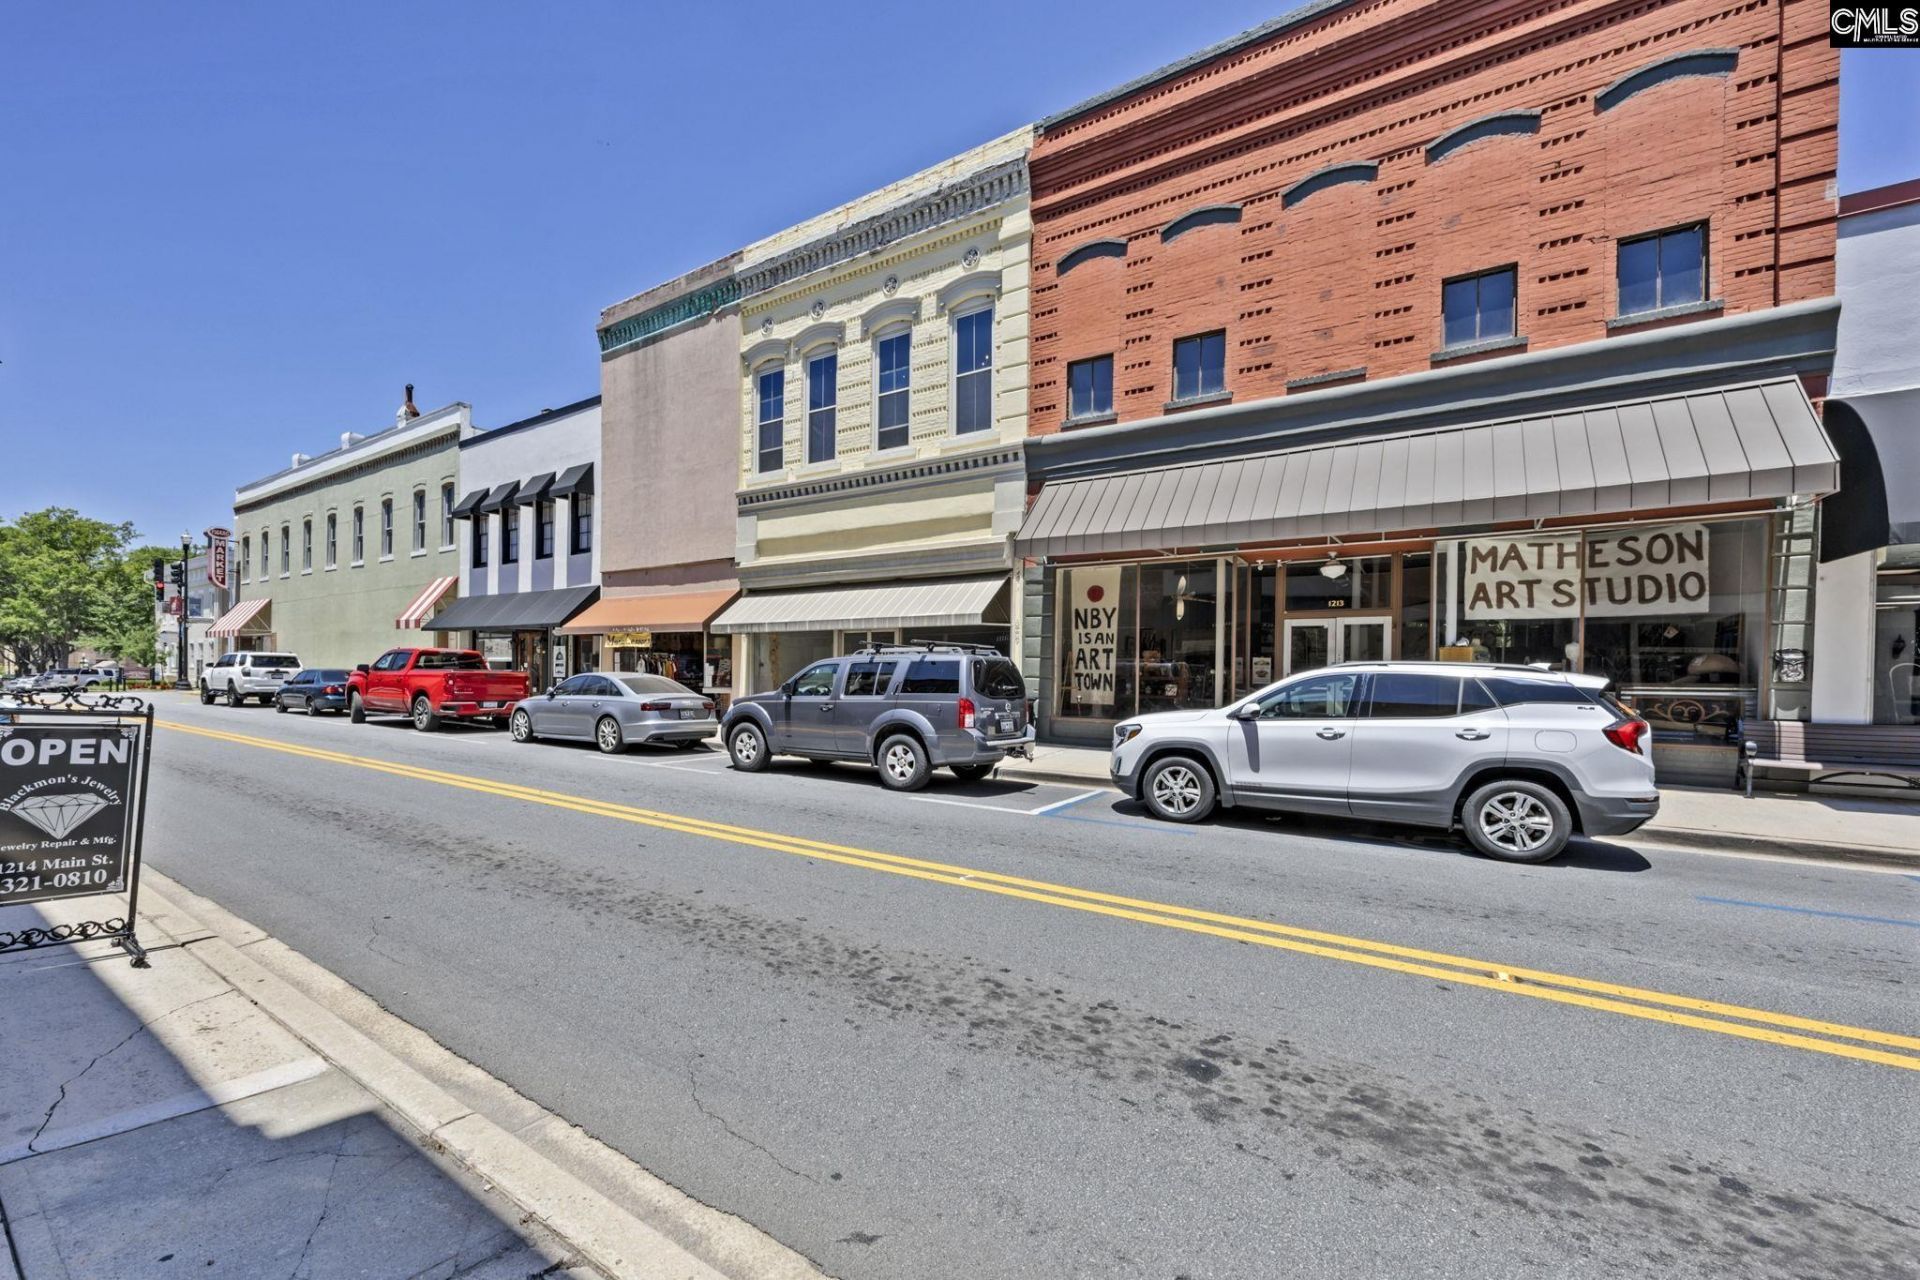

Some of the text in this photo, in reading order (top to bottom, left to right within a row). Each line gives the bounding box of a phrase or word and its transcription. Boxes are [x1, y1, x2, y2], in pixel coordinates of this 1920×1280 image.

[216, 540, 226, 582] MARKET
[1470, 530, 1704, 574] MATHESON
[1468, 571, 1706, 611] ART STUDIO
[1328, 599, 1345, 607] 1213
[1074, 607, 1116, 629] NBY
[1079, 632, 1114, 644] IS AN
[1075, 648, 1113, 670] ART
[1074, 673, 1113, 691] TOWN
[1, 738, 129, 766] OPEN
[0, 773, 122, 812] Blackmon's Jewelry
[0, 836, 117, 851] ewelry Repair & Mfg.
[42, 856, 86, 871] Main
[91, 854, 114, 866] St.
